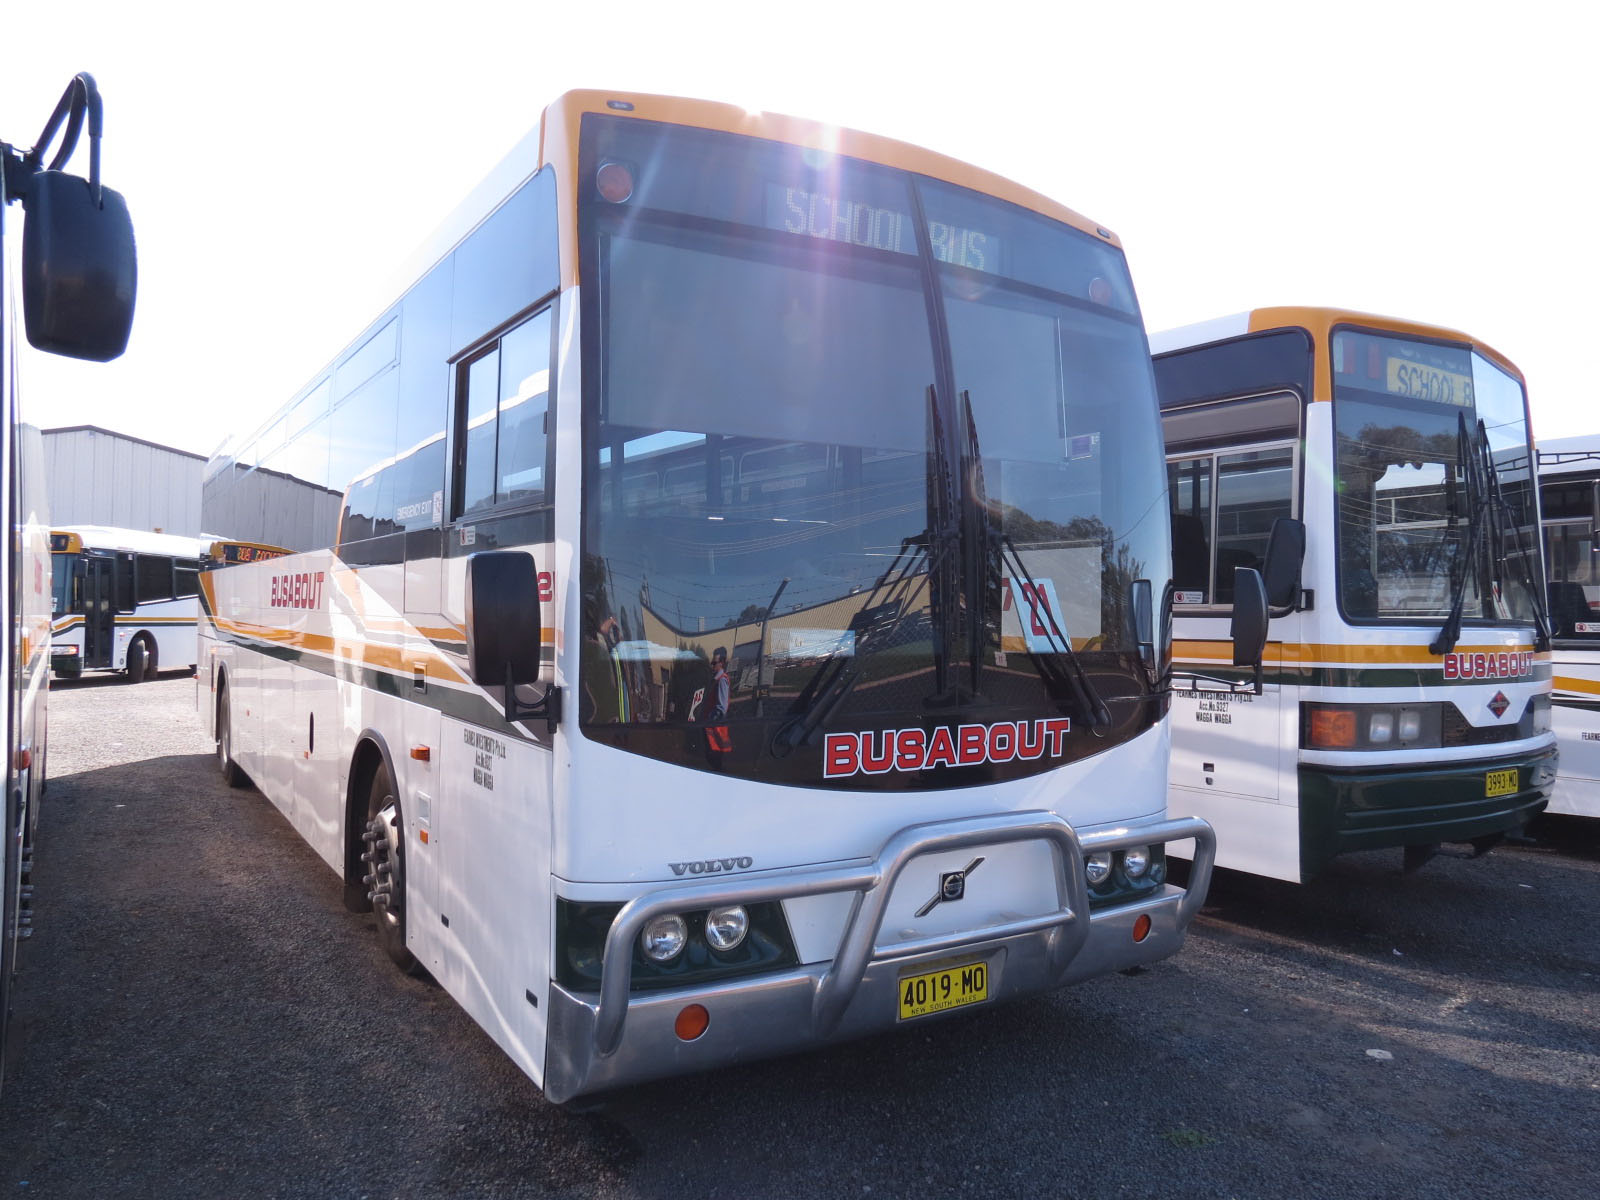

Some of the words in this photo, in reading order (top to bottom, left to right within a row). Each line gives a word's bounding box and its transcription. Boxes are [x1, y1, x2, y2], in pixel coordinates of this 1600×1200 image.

[929, 221, 986, 271] BUS
[271, 571, 325, 610] BUSABOUT
[1443, 651, 1534, 680] BUSABOUT
[1196, 712, 1213, 723] WAGGA
[1214, 714, 1232, 725] WAGGA
[824, 718, 1070, 778] BUSABOUT
[668, 856, 753, 876] VOLVO
[930, 1001, 953, 1011] SOUTH
[956, 994, 977, 1005] WALES
